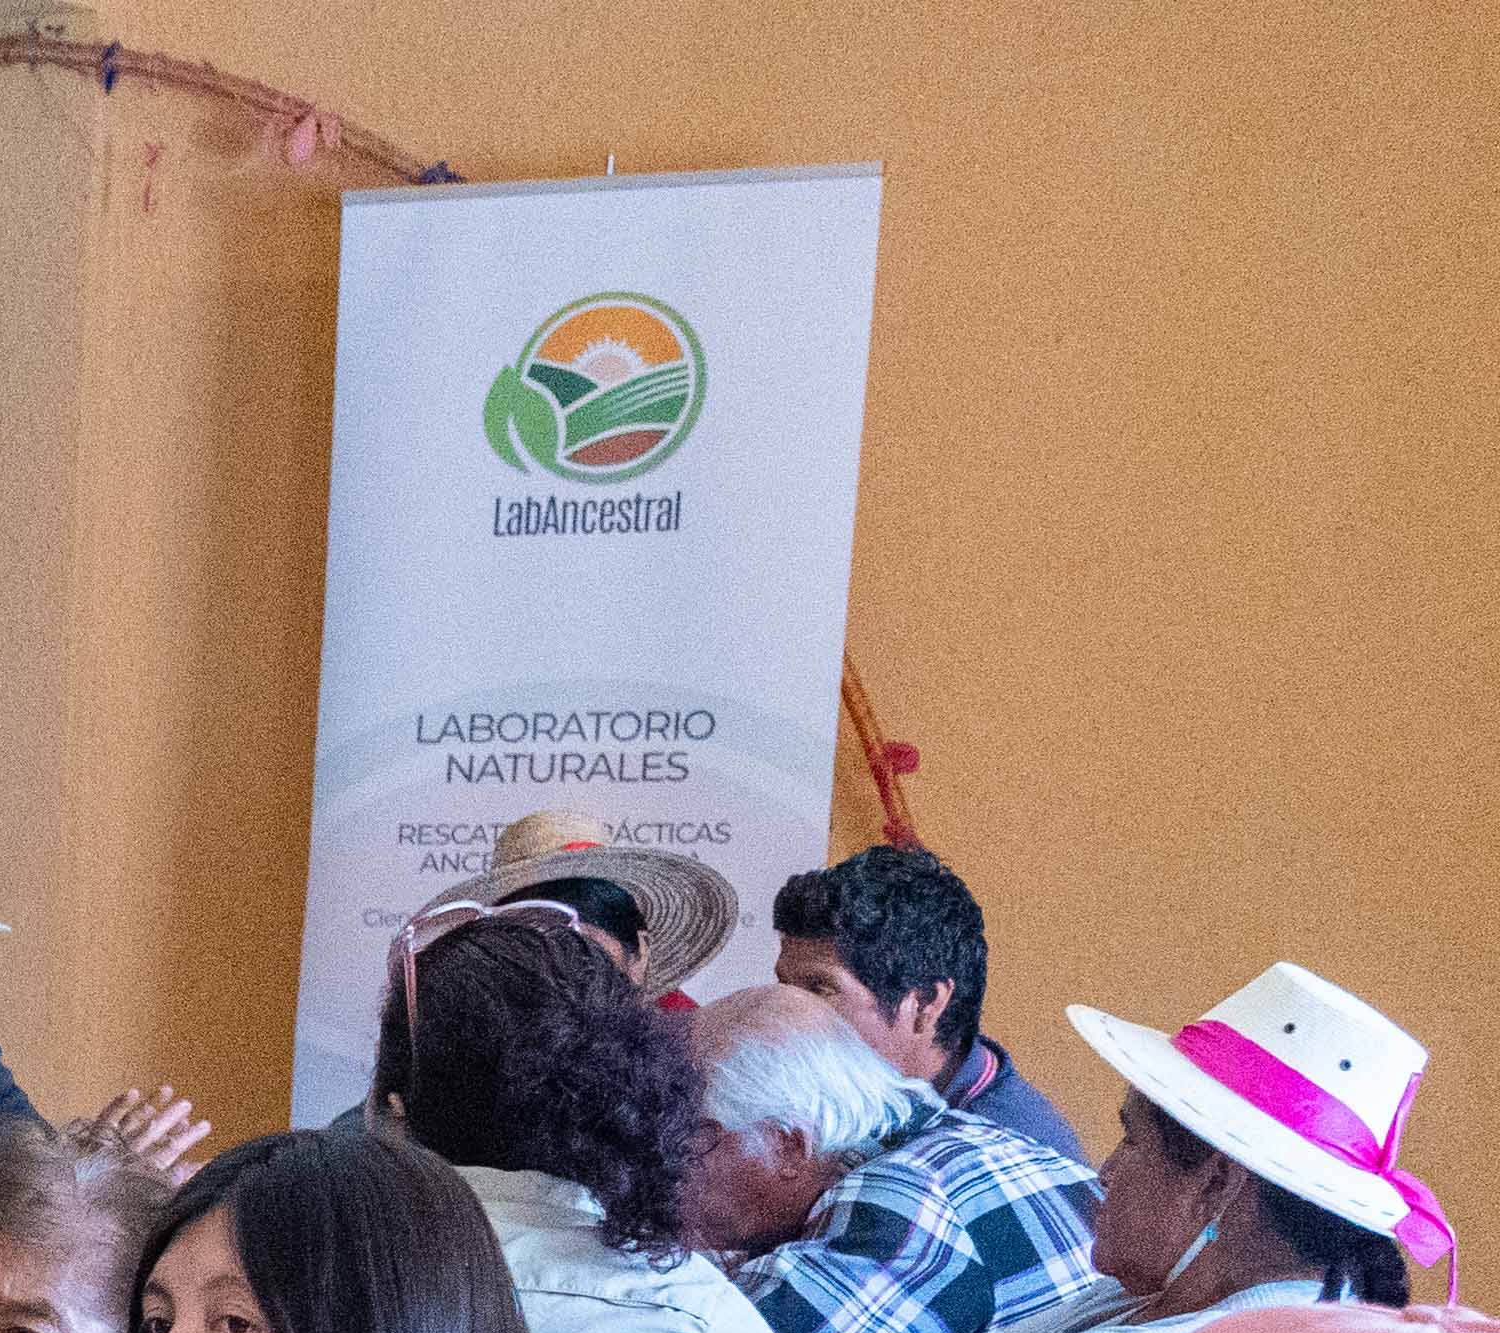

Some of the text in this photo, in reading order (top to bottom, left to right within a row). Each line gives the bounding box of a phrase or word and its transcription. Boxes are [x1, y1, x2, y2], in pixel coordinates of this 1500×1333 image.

[492, 491, 682, 537] LabAncestral
[414, 710, 716, 746] LABORATORIO
[445, 751, 690, 785] NATURALES
[397, 817, 733, 847] RESCAT ÁCTICAS
